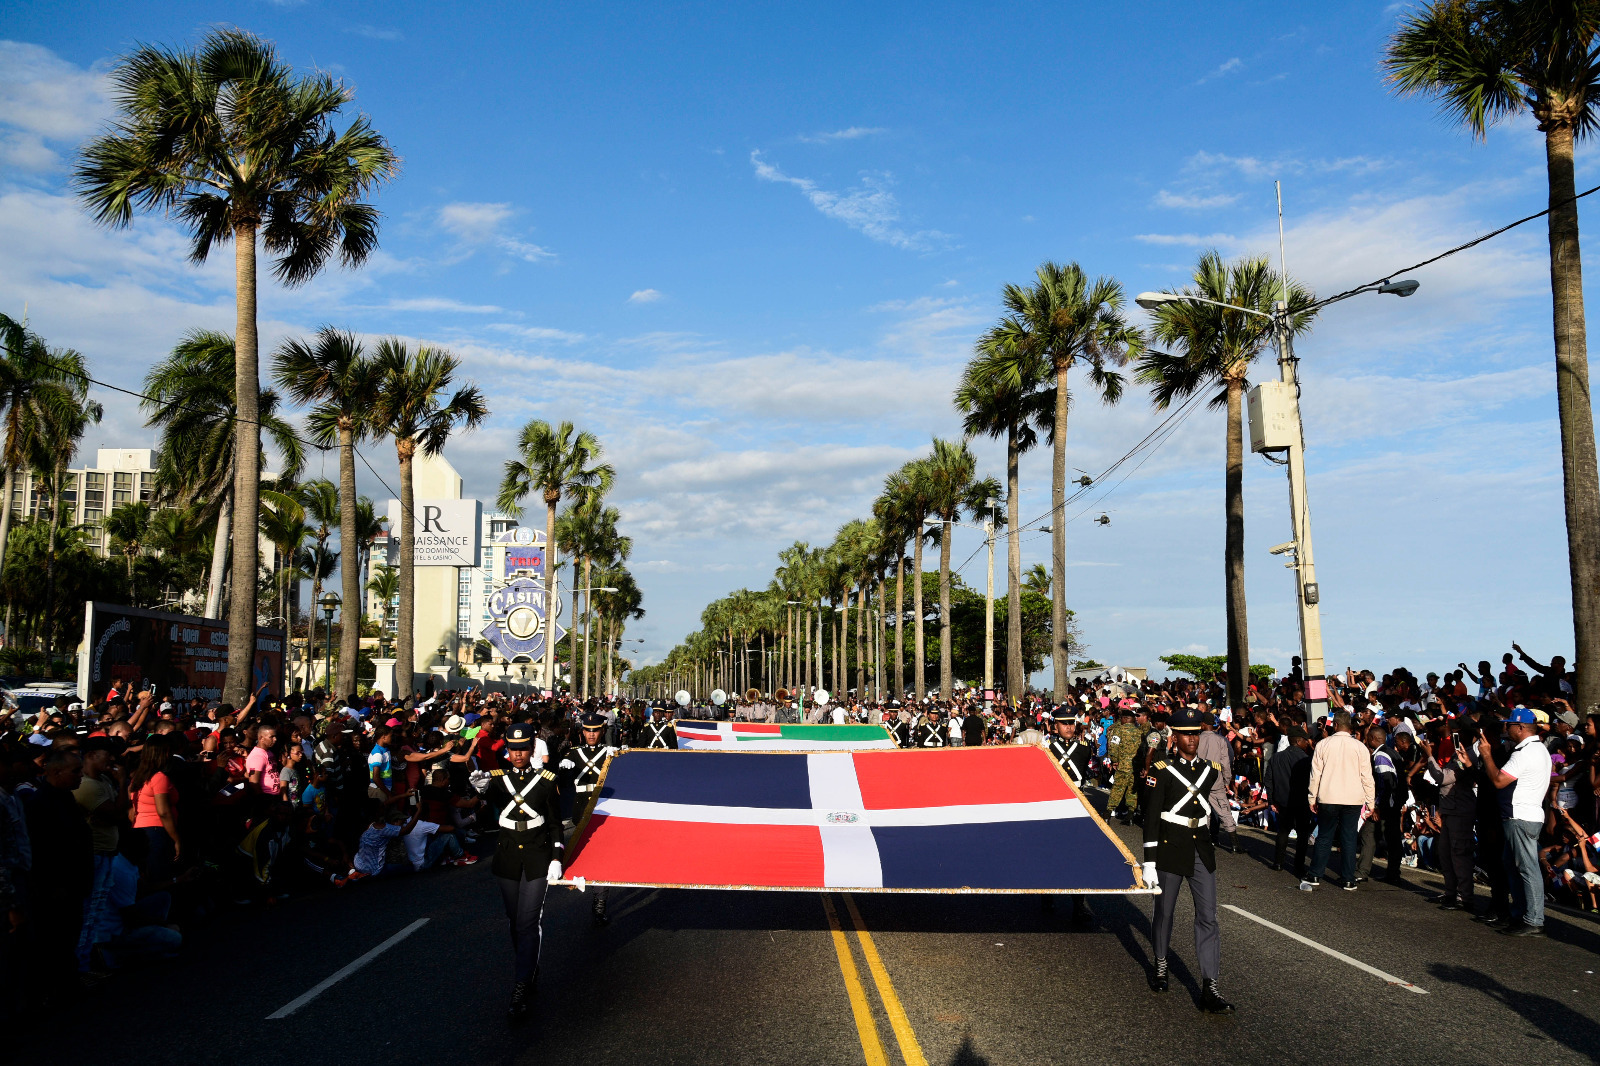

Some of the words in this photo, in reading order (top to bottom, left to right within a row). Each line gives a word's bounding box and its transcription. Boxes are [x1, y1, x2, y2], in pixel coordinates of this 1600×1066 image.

[422, 505, 450, 533] R
[509, 557, 541, 566] TRIO
[491, 592, 545, 615] CASIN
[182, 627, 200, 643] open
